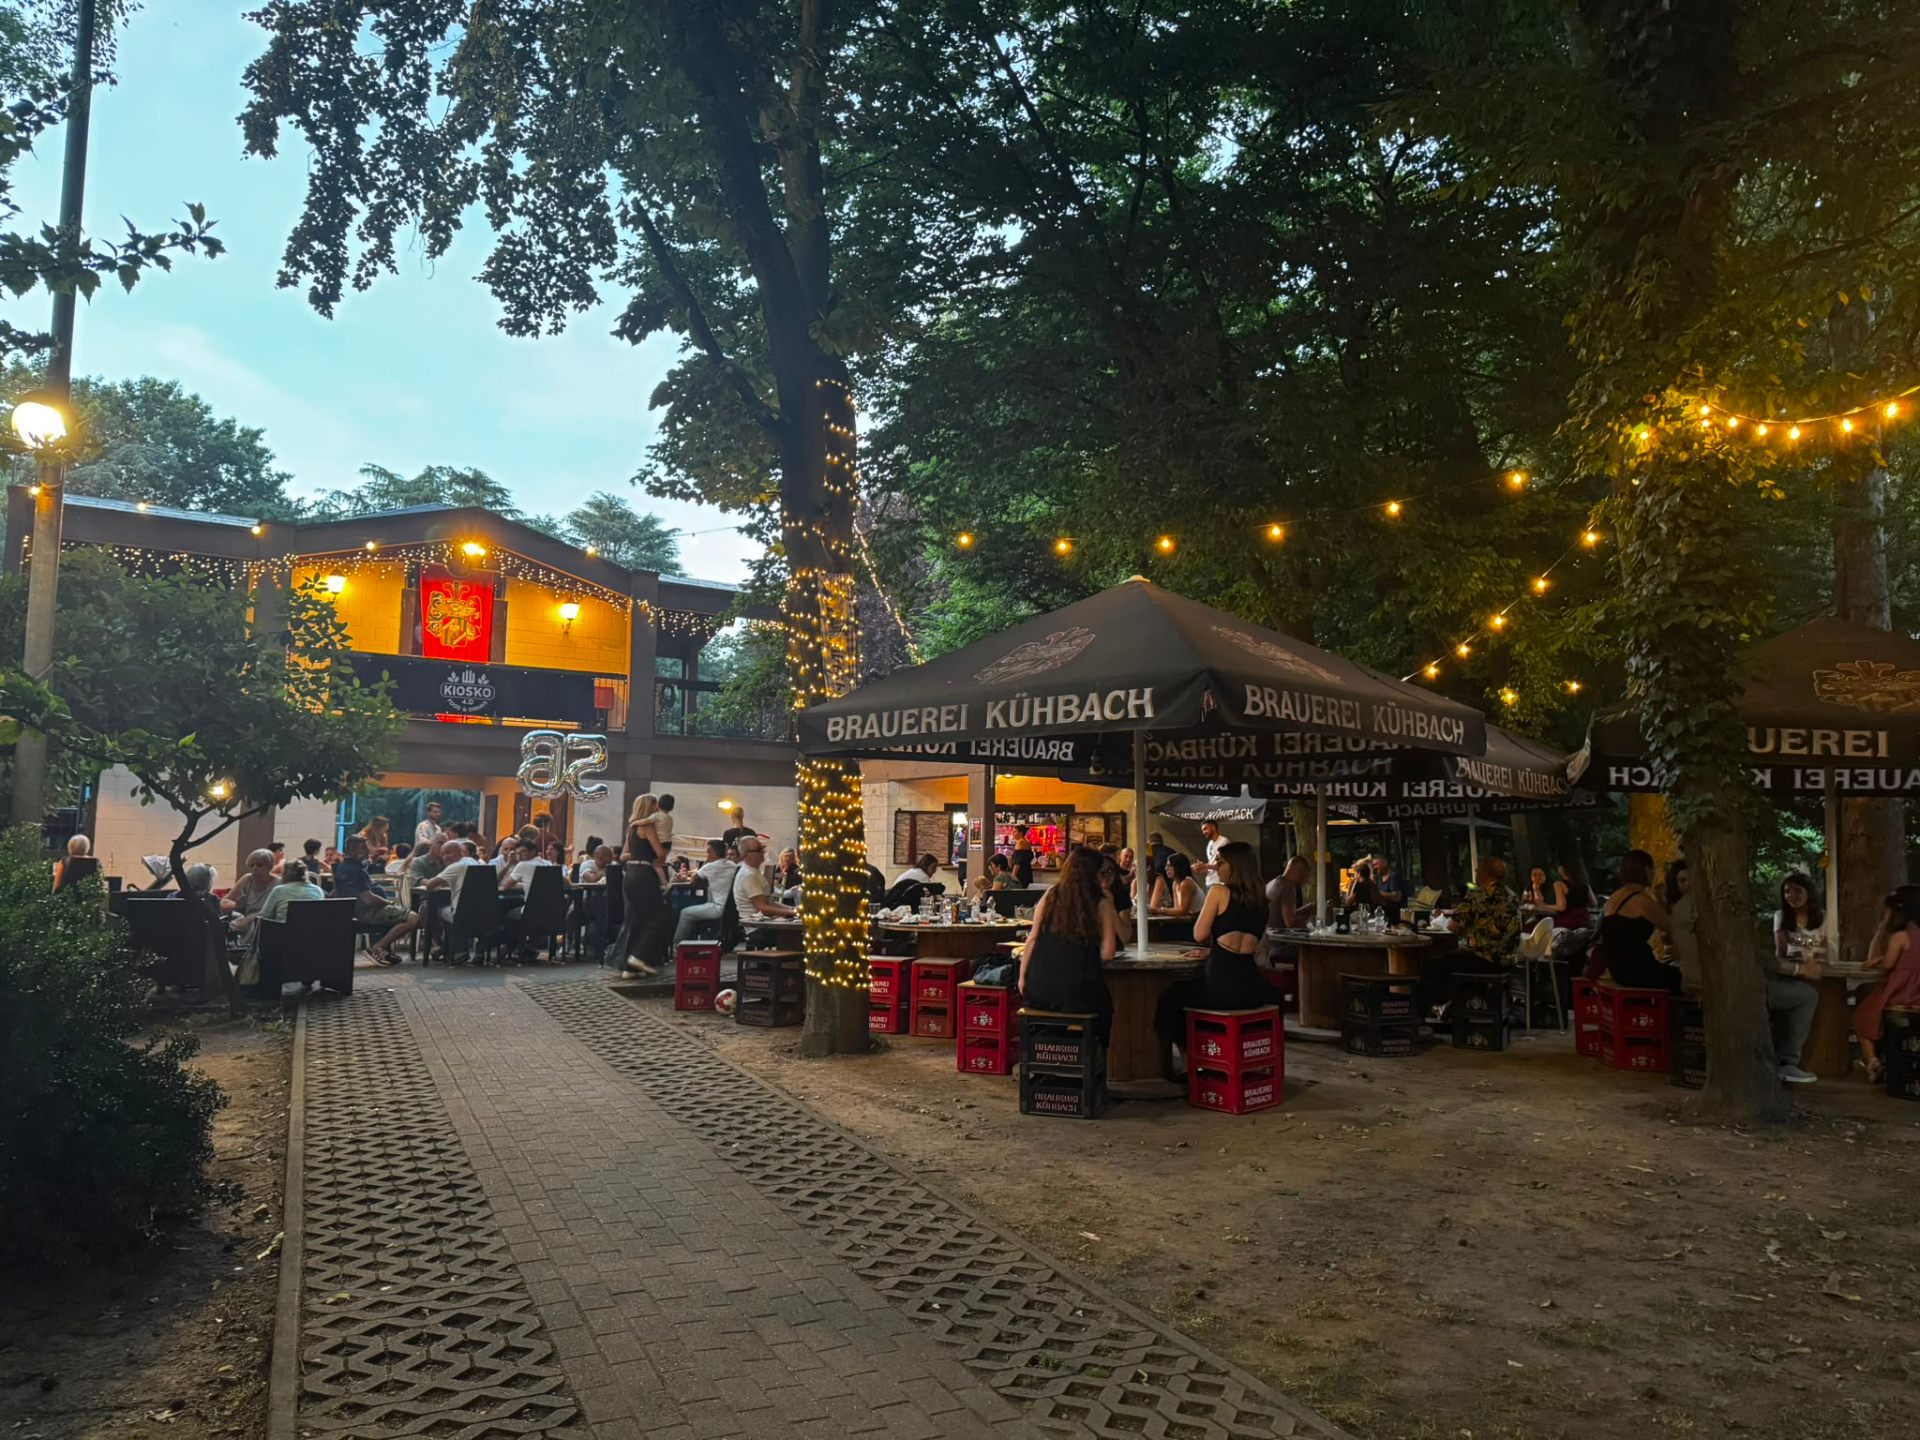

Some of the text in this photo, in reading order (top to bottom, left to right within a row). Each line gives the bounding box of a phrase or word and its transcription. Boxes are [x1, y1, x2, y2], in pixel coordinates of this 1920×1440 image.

[443, 685, 492, 698] KIOSKO
[826, 687, 1155, 742] BRAUEREI KÜHBACH
[1243, 684, 1465, 745] BRAUEREI KÜHBACH
[1748, 727, 1889, 758] UEREI
